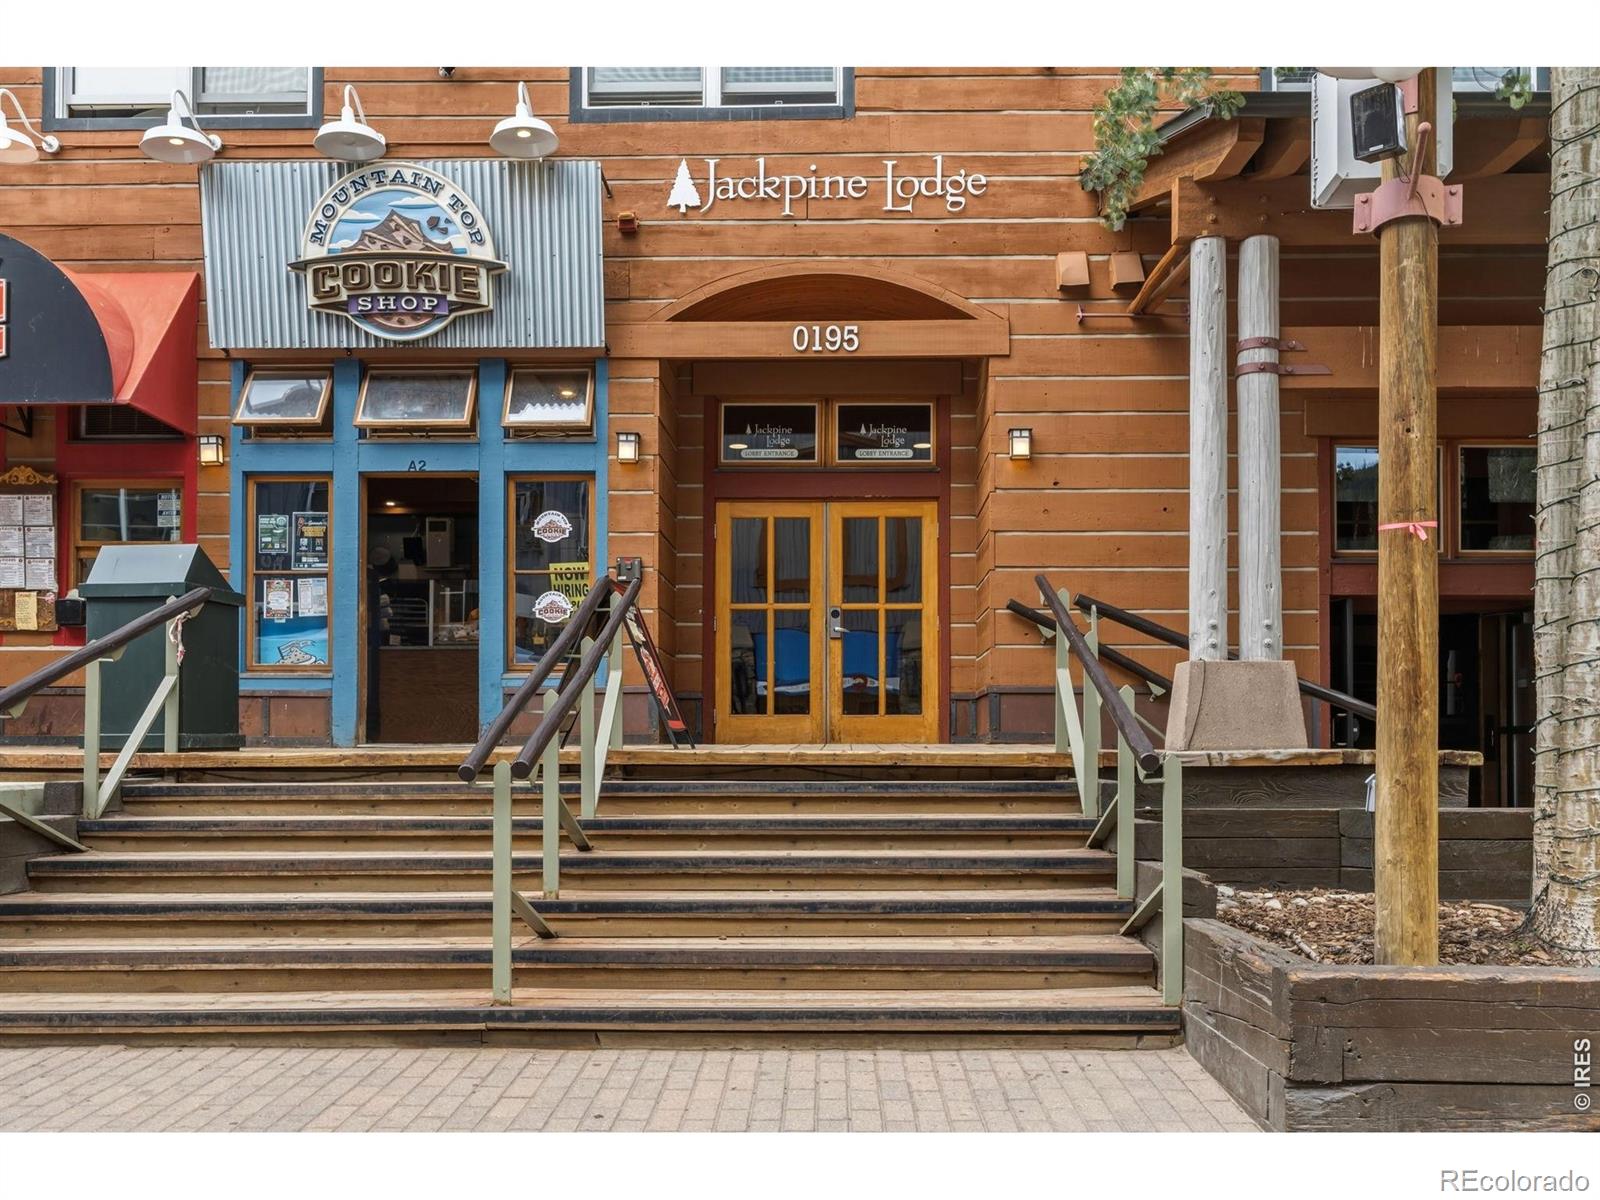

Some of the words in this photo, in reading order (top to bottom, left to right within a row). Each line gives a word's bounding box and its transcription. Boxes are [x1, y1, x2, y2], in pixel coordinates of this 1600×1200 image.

[700, 157, 868, 217] Jackpine
[882, 154, 988, 214] Lodge
[310, 169, 445, 247] MOUNTAIN
[449, 194, 486, 246] TOP
[312, 260, 481, 300] COOKIE
[357, 295, 439, 312] SHOP
[792, 325, 860, 352] 0195
[754, 423, 793, 437] Jackpine
[869, 423, 908, 437] Jackpine
[766, 434, 791, 448] Lodge
[880, 434, 905, 448] Lodge
[408, 460, 426, 471] A2
[553, 567, 585, 581] NOW
[553, 583, 589, 598] HIRING
[538, 608, 568, 616] COOKIE
